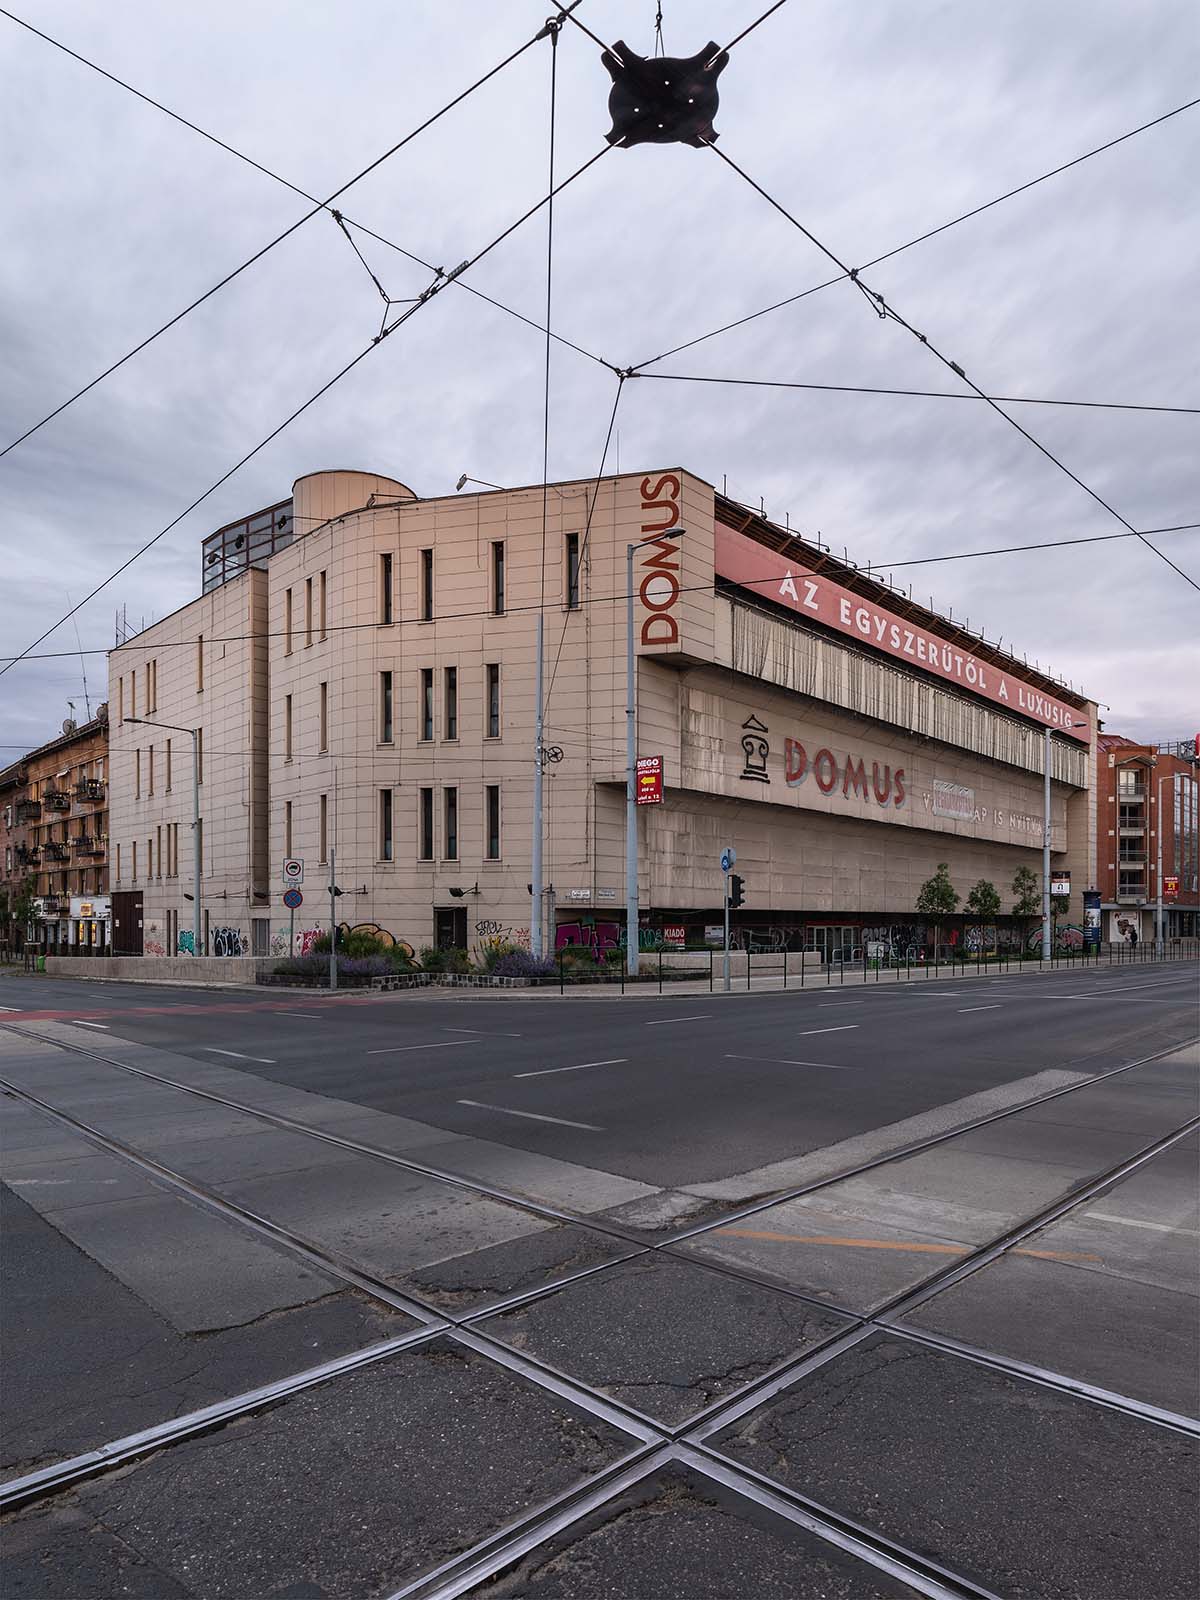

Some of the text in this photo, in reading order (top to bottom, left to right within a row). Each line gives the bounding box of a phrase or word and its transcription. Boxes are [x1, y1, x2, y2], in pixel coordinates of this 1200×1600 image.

[640, 474, 680, 645] DOMUS
[779, 570, 1072, 729] AZ EGYSZERŰTŐL A LUXUSIG
[637, 759, 659, 768] DIEGO
[785, 737, 907, 809] DOMUS
[994, 809, 1003, 825] IS
[664, 927, 685, 938] KIADÓ
